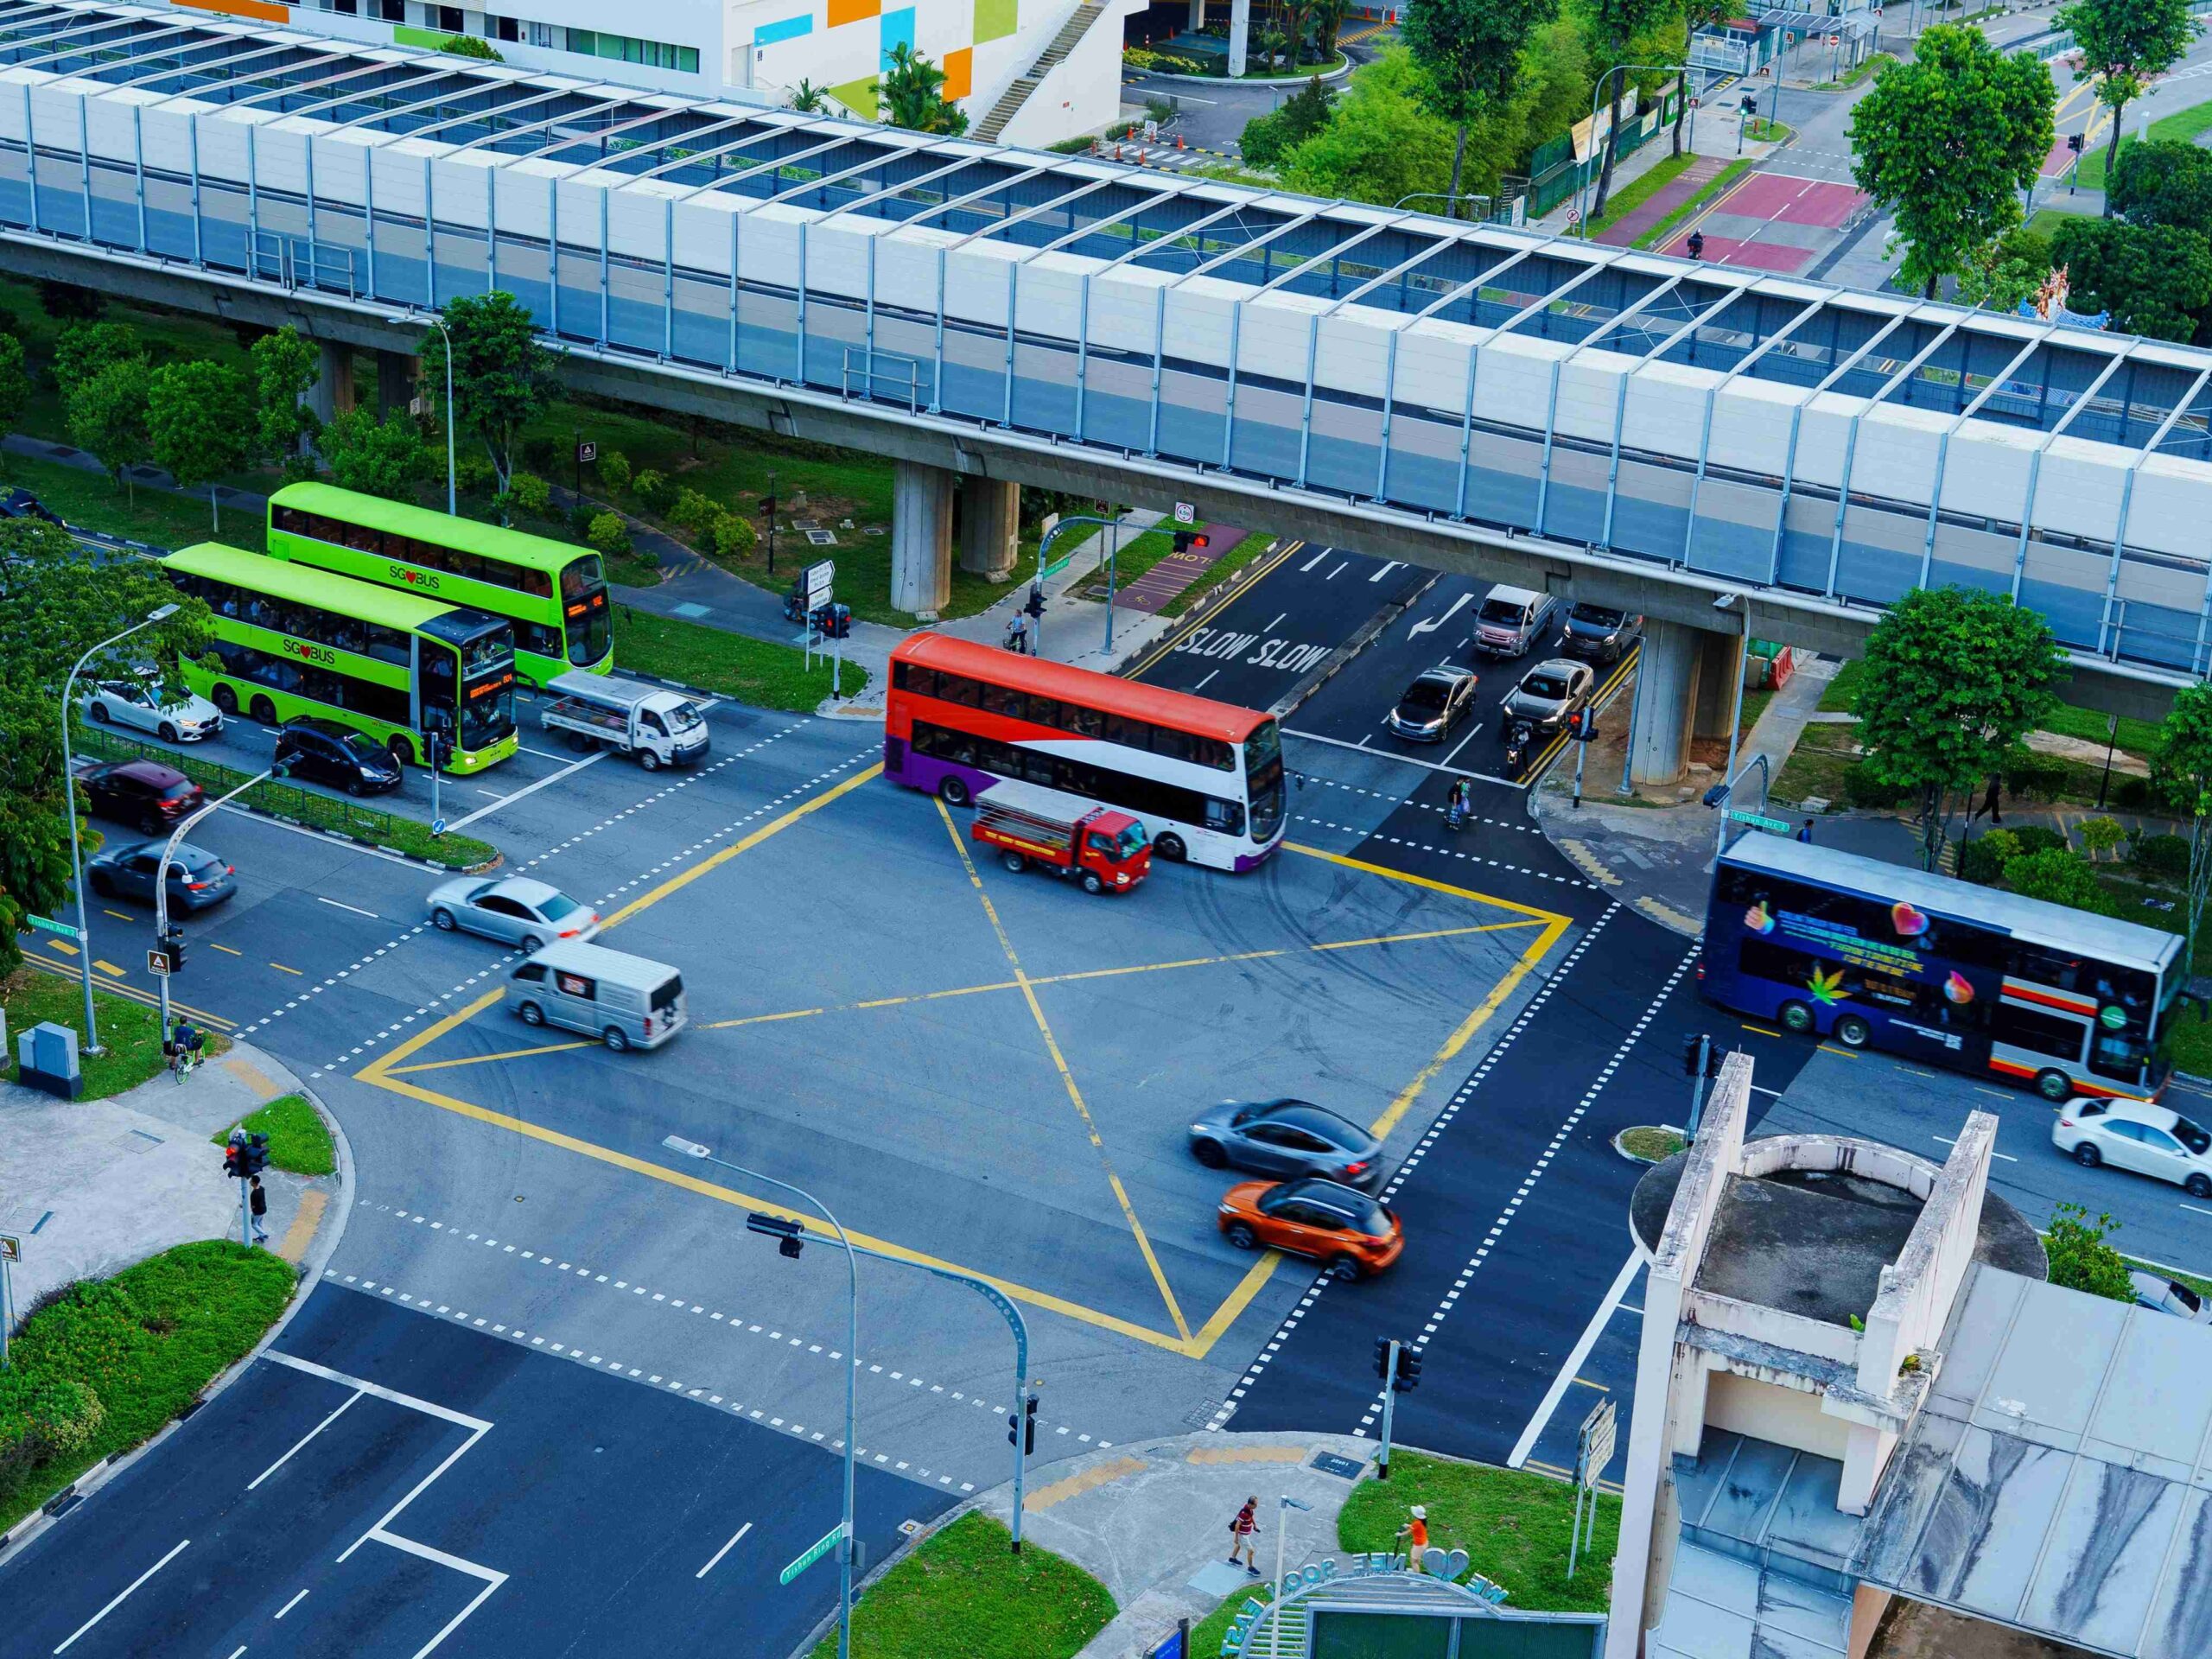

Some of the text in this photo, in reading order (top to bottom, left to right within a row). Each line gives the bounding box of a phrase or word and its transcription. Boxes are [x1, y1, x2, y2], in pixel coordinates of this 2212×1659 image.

[1174, 627, 1333, 673] SLOW SLOW
[1734, 812, 1760, 824] Yishun
[1764, 819, 1778, 828] Ave
[785, 1529, 842, 1579] Yishun Ring Rd
